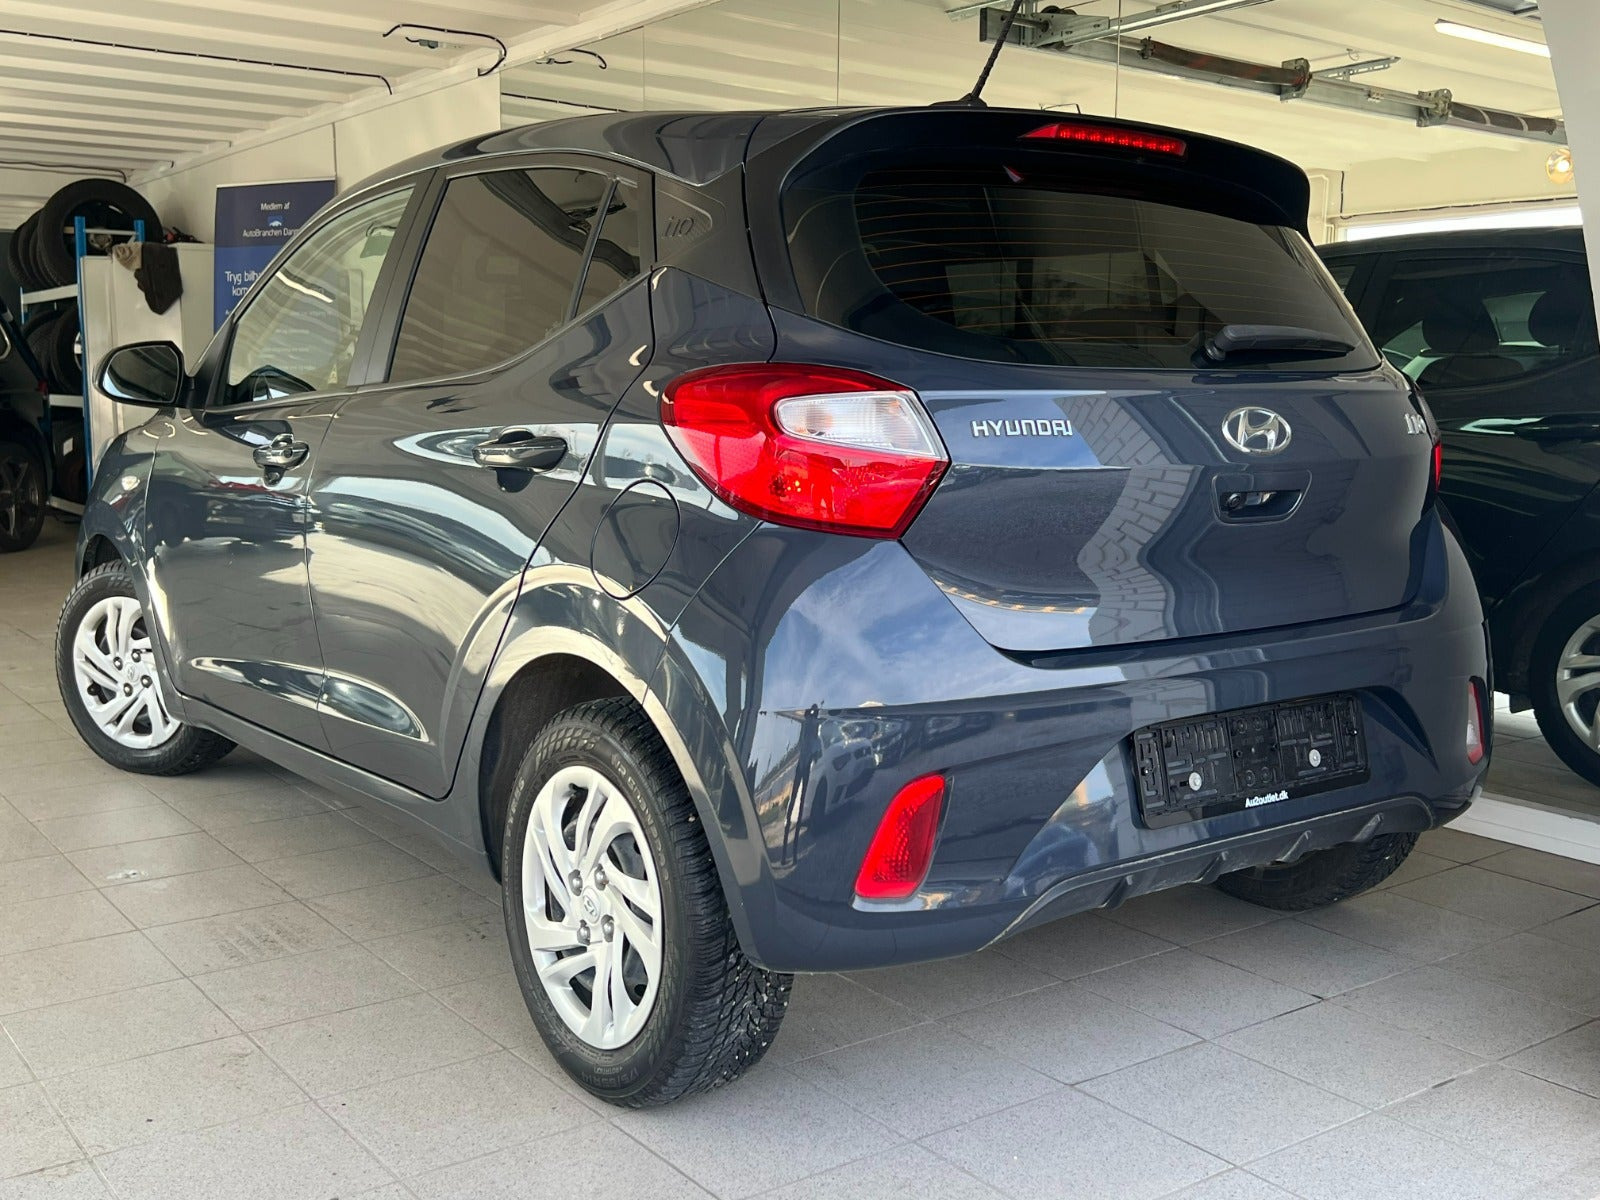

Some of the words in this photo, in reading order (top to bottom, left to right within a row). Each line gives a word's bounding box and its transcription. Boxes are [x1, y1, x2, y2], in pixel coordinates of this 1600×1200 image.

[260, 202, 283, 211] Medlem
[284, 202, 290, 210] af
[225, 271, 242, 285] Tryg
[244, 270, 261, 282] bilh
[971, 419, 1074, 437] HYUNDAI
[1245, 790, 1289, 808] Au2outlet.dk
